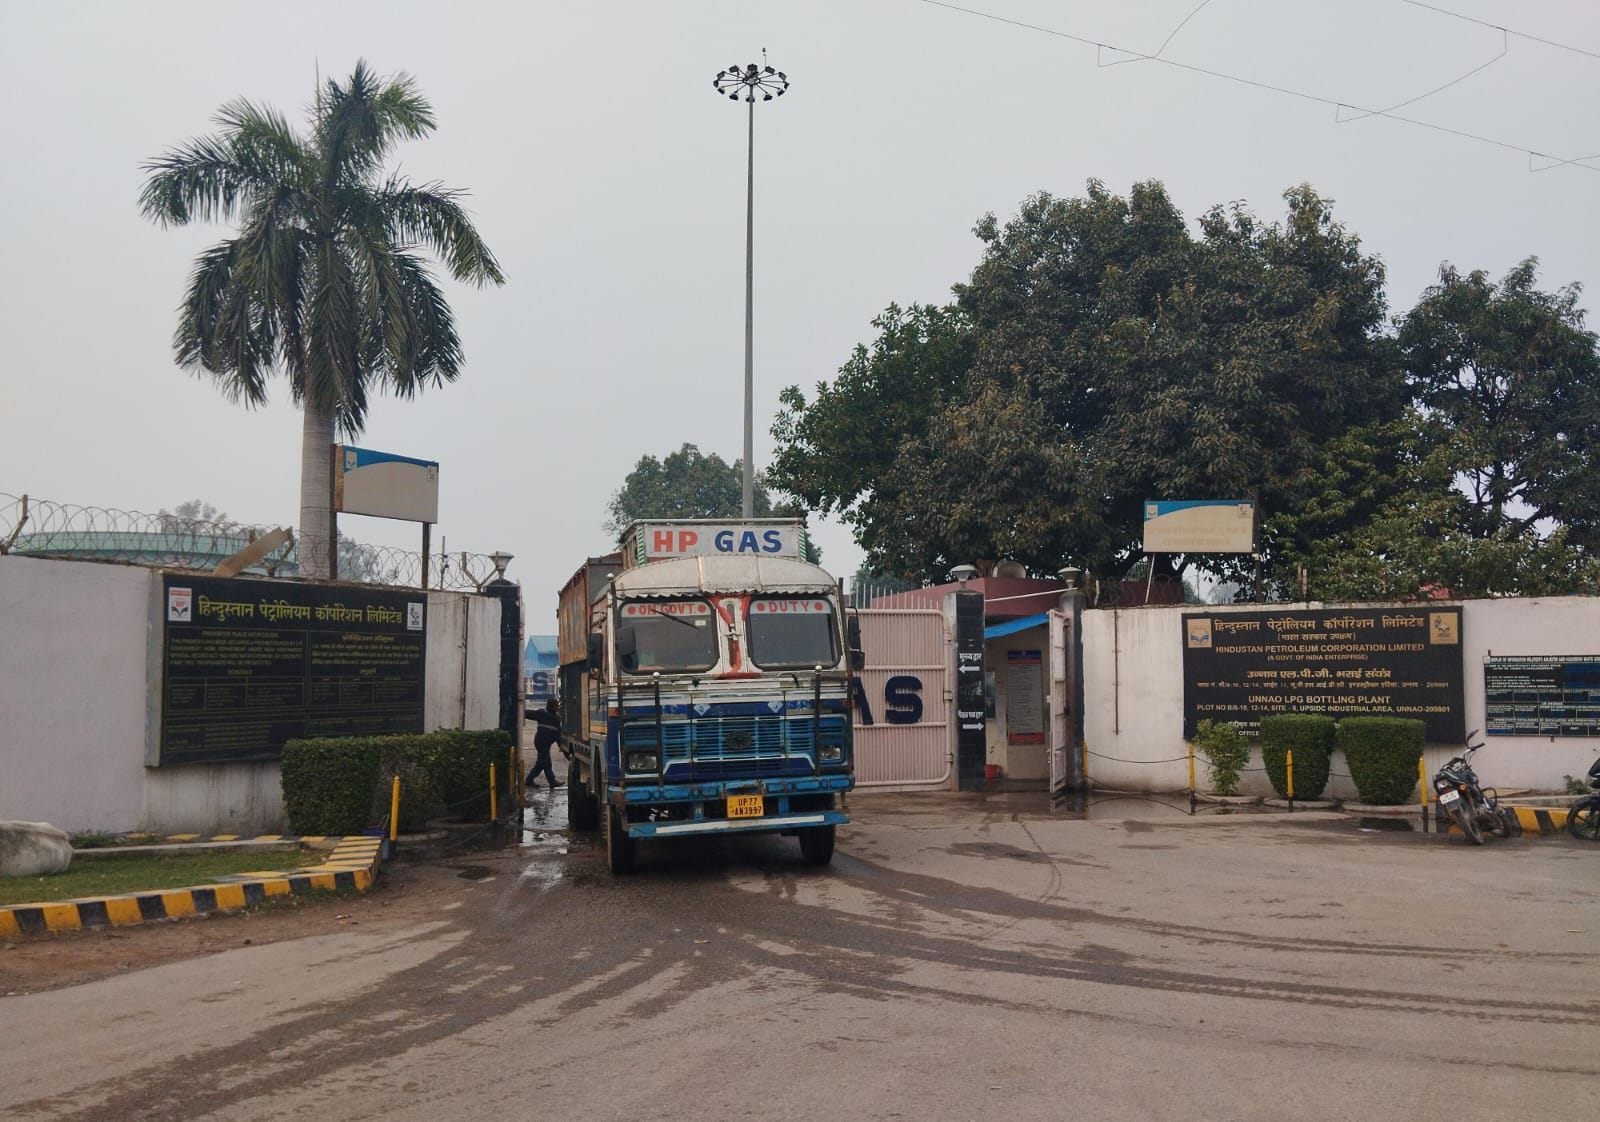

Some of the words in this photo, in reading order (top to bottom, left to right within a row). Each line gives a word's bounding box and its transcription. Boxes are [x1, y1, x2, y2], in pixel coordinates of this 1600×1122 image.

[653, 530, 699, 553] HP
[714, 529, 783, 554] GAS
[198, 594, 255, 622] हिन्दुस्तान
[259, 599, 311, 622] पेट्रोलियम
[366, 604, 403, 624] लिमिटेड
[639, 603, 658, 615] ON
[768, 601, 808, 613] DUTY
[1214, 619, 1261, 634] हिन्दुस्तान
[1266, 617, 1316, 632] पेट्रोलियम
[1382, 614, 1424, 628] लिमिटेड
[1301, 632, 1327, 641] सरकार
[1215, 645, 1263, 653] HINDUSTAN
[1265, 644, 1319, 653] PETROLEUM
[1320, 643, 1386, 652] CORPORATION
[1388, 643, 1425, 651] LIMITED
[1280, 667, 1333, 678] एल.पी.जी.
[1336, 667, 1362, 678] भराई
[1248, 695, 1282, 703] UNNAO
[1284, 695, 1303, 703] LPG
[1306, 695, 1355, 704] BOTTLING
[1357, 695, 1391, 704] PLANT
